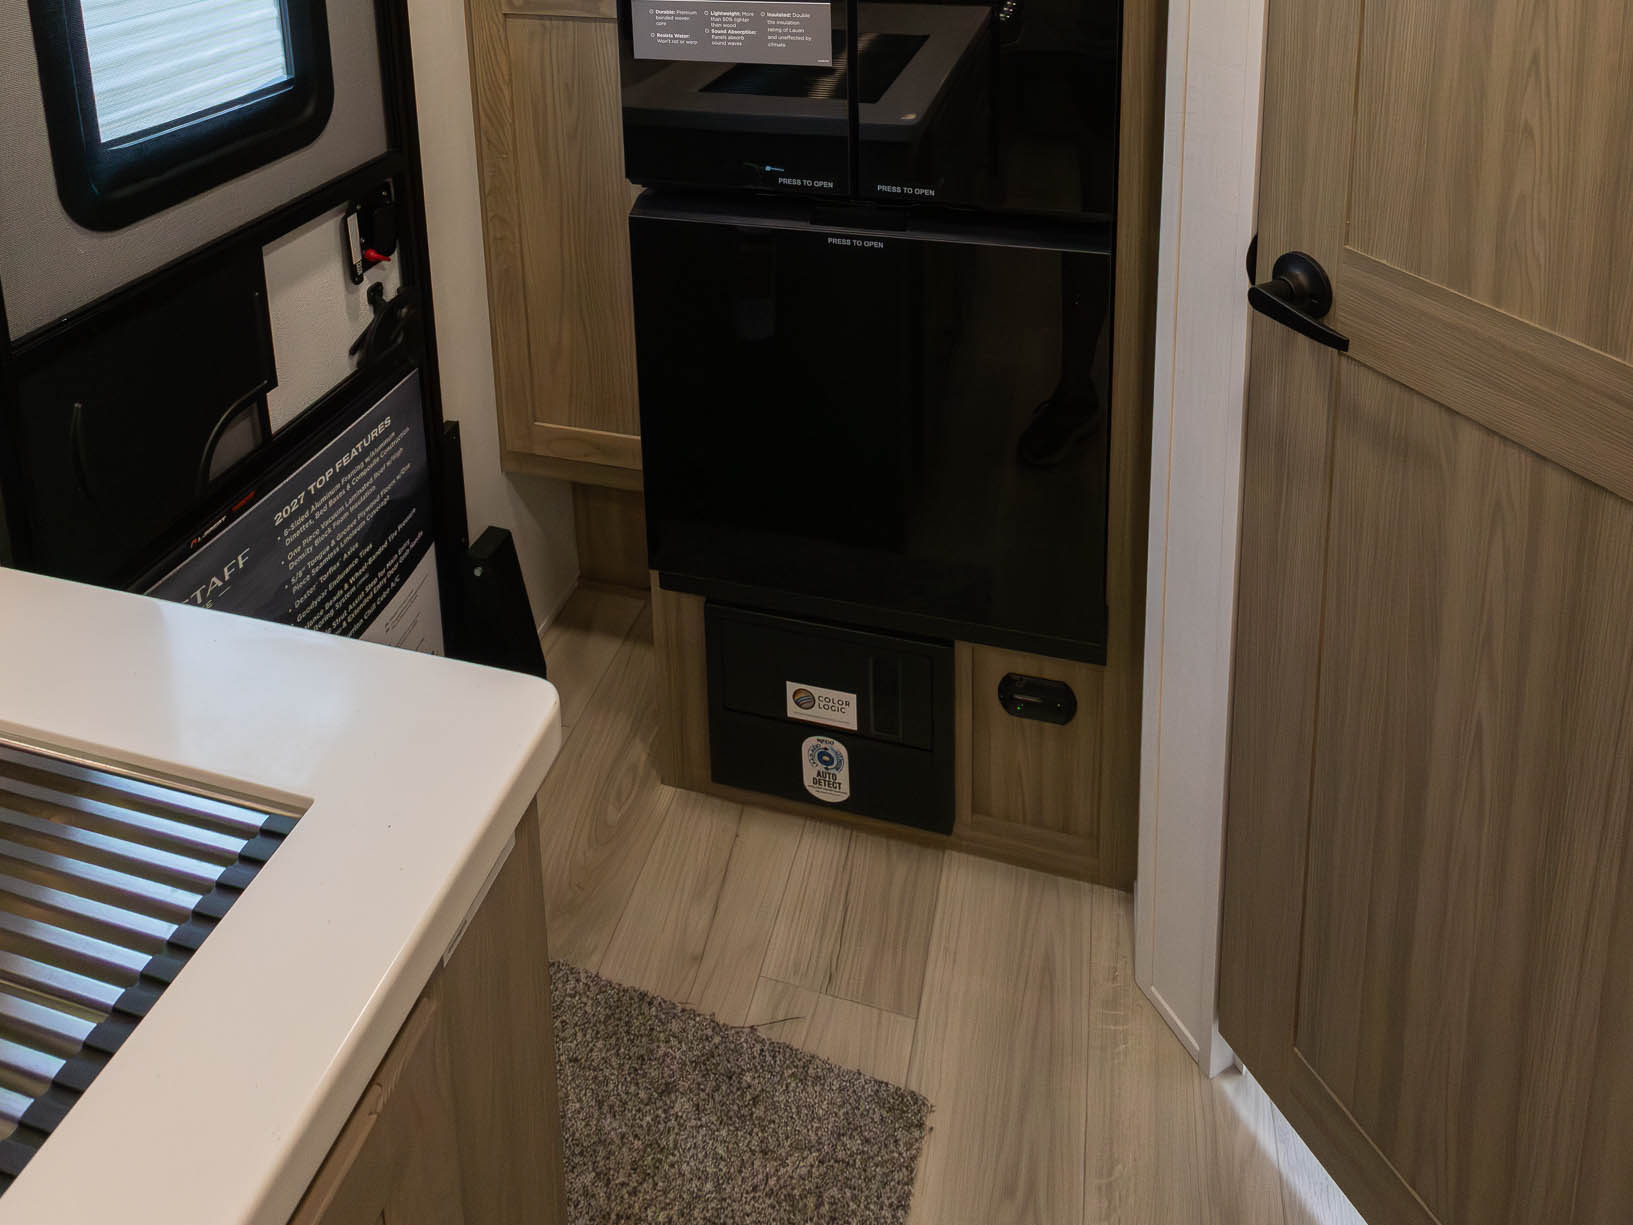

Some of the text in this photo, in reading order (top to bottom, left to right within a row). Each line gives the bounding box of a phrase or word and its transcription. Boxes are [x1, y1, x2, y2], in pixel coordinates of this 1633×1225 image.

[779, 177, 833, 189] PRESS TO OPEN
[877, 184, 901, 193] PRESS
[914, 188, 935, 196] OPEN
[828, 237, 884, 249] PRESS TO OPEN
[274, 492, 306, 526] 2027
[308, 468, 334, 495] TOP
[335, 416, 391, 472] FEATURES
[184, 547, 250, 605] TAFF
[818, 696, 850, 707] COLOR
[818, 704, 846, 714] LOGIC
[816, 770, 837, 781] AUTO
[812, 777, 842, 790] DETECT
